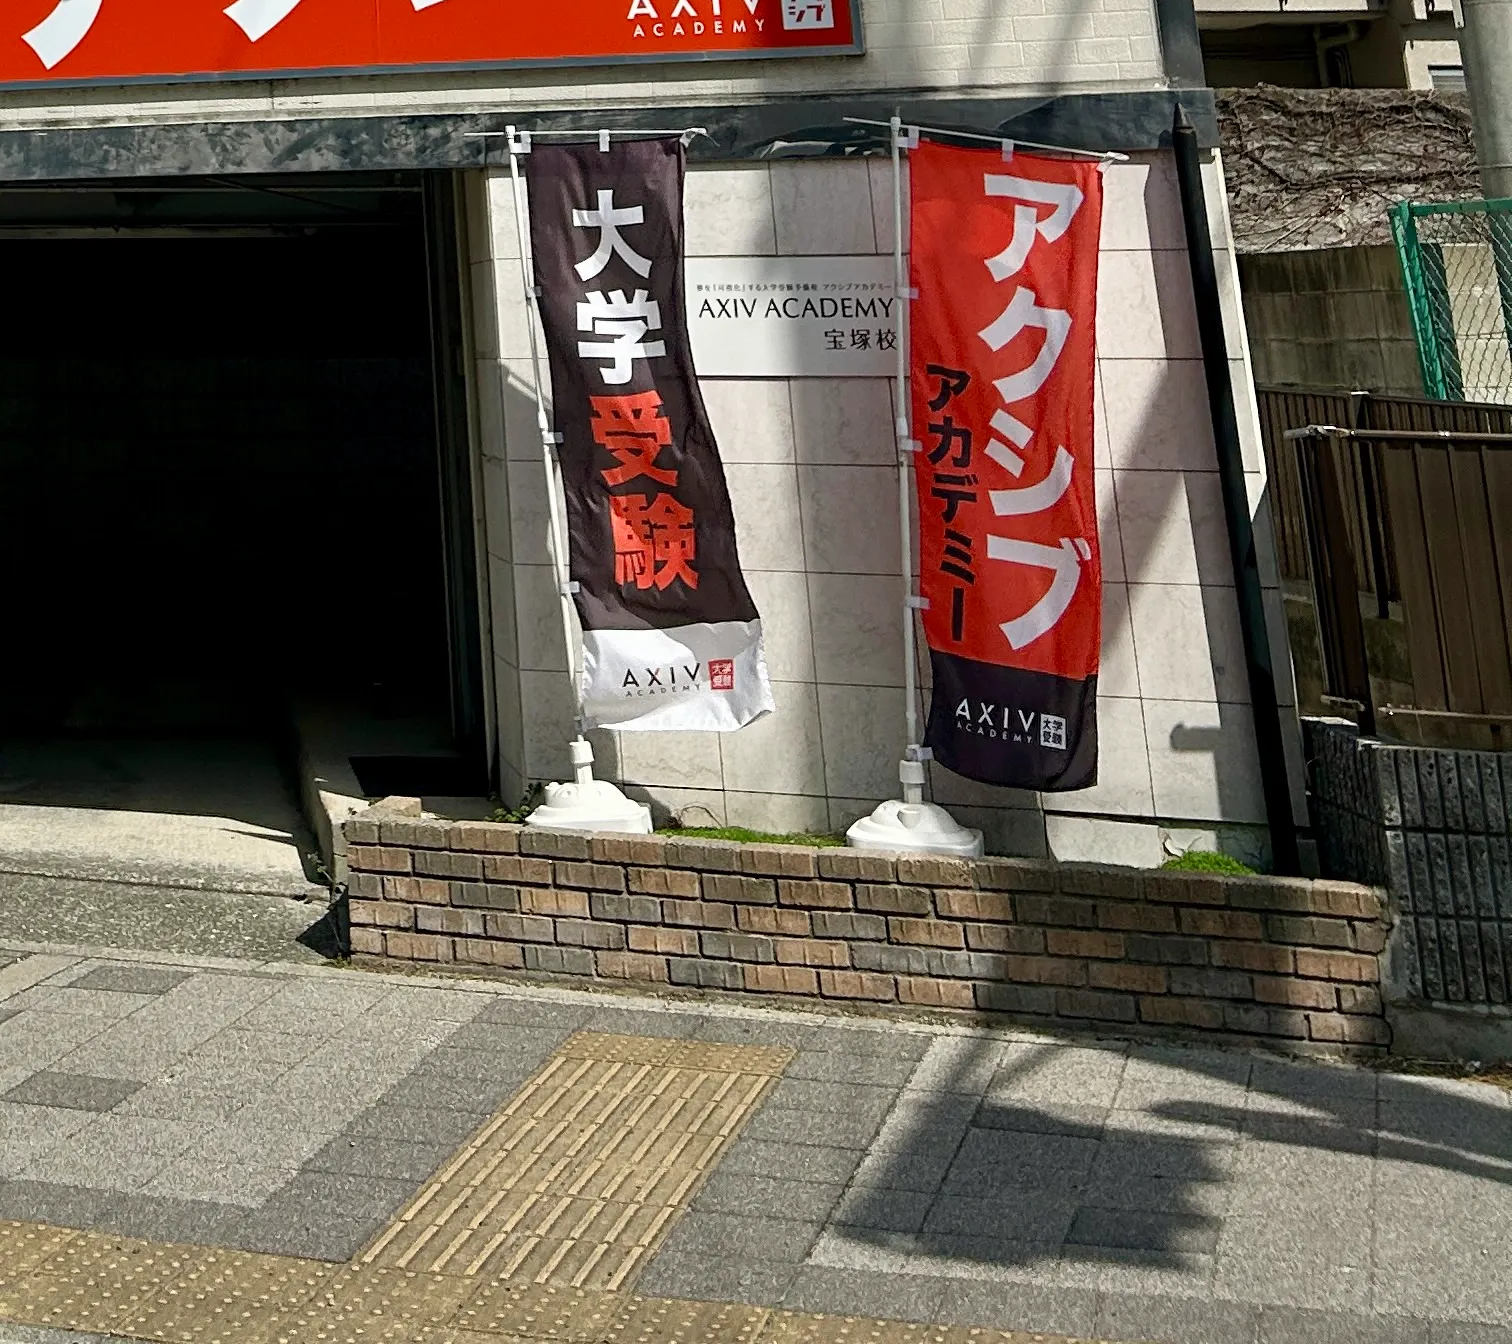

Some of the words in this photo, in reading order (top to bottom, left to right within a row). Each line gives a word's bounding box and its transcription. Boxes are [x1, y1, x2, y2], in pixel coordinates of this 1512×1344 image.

[633, 18, 765, 38] ACADEMY
[698, 297, 758, 319] AXIV
[764, 297, 894, 319] ACADEMY
[824, 328, 897, 351] 宝塚校
[571, 188, 699, 591] 大学受験
[978, 172, 1092, 652] アクシブ
[926, 363, 976, 642] アカデミー
[621, 662, 701, 688] AXIV
[625, 683, 702, 698] ACADEMY
[955, 697, 1036, 733] AXIV
[956, 721, 1033, 744] ACADEMY
